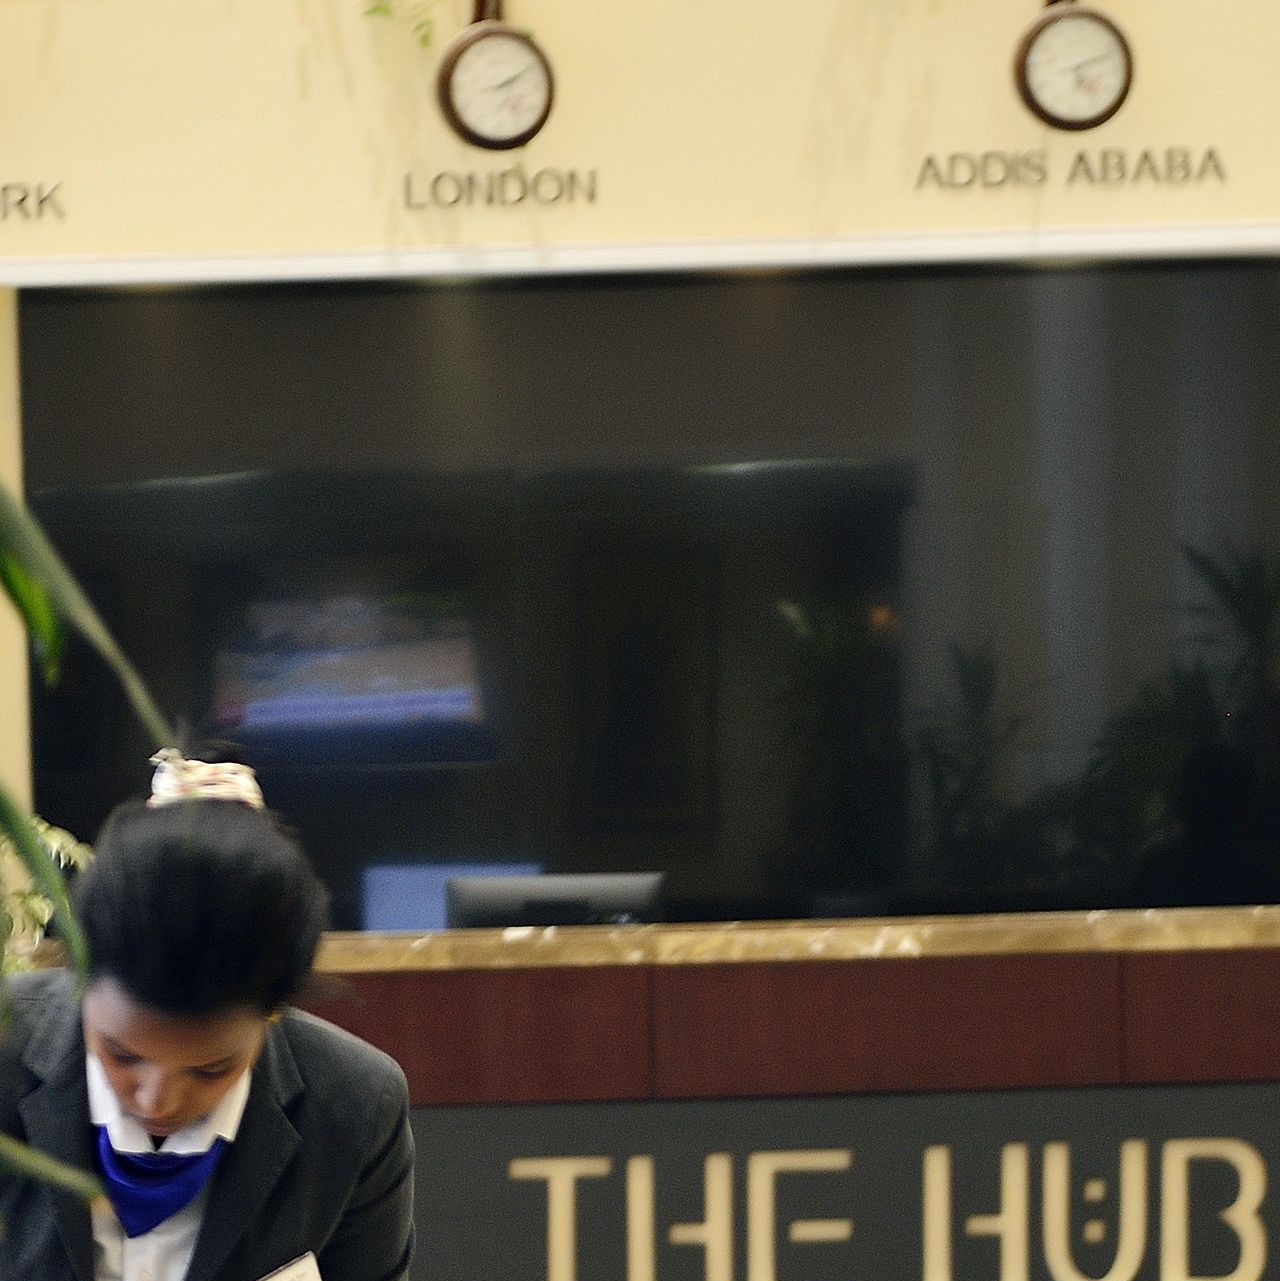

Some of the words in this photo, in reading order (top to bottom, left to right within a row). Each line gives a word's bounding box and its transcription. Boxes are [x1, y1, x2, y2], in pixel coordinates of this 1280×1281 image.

[403, 166, 598, 209] LONDON
[915, 150, 1048, 189] ADDIS
[1066, 147, 1226, 187] ABABA
